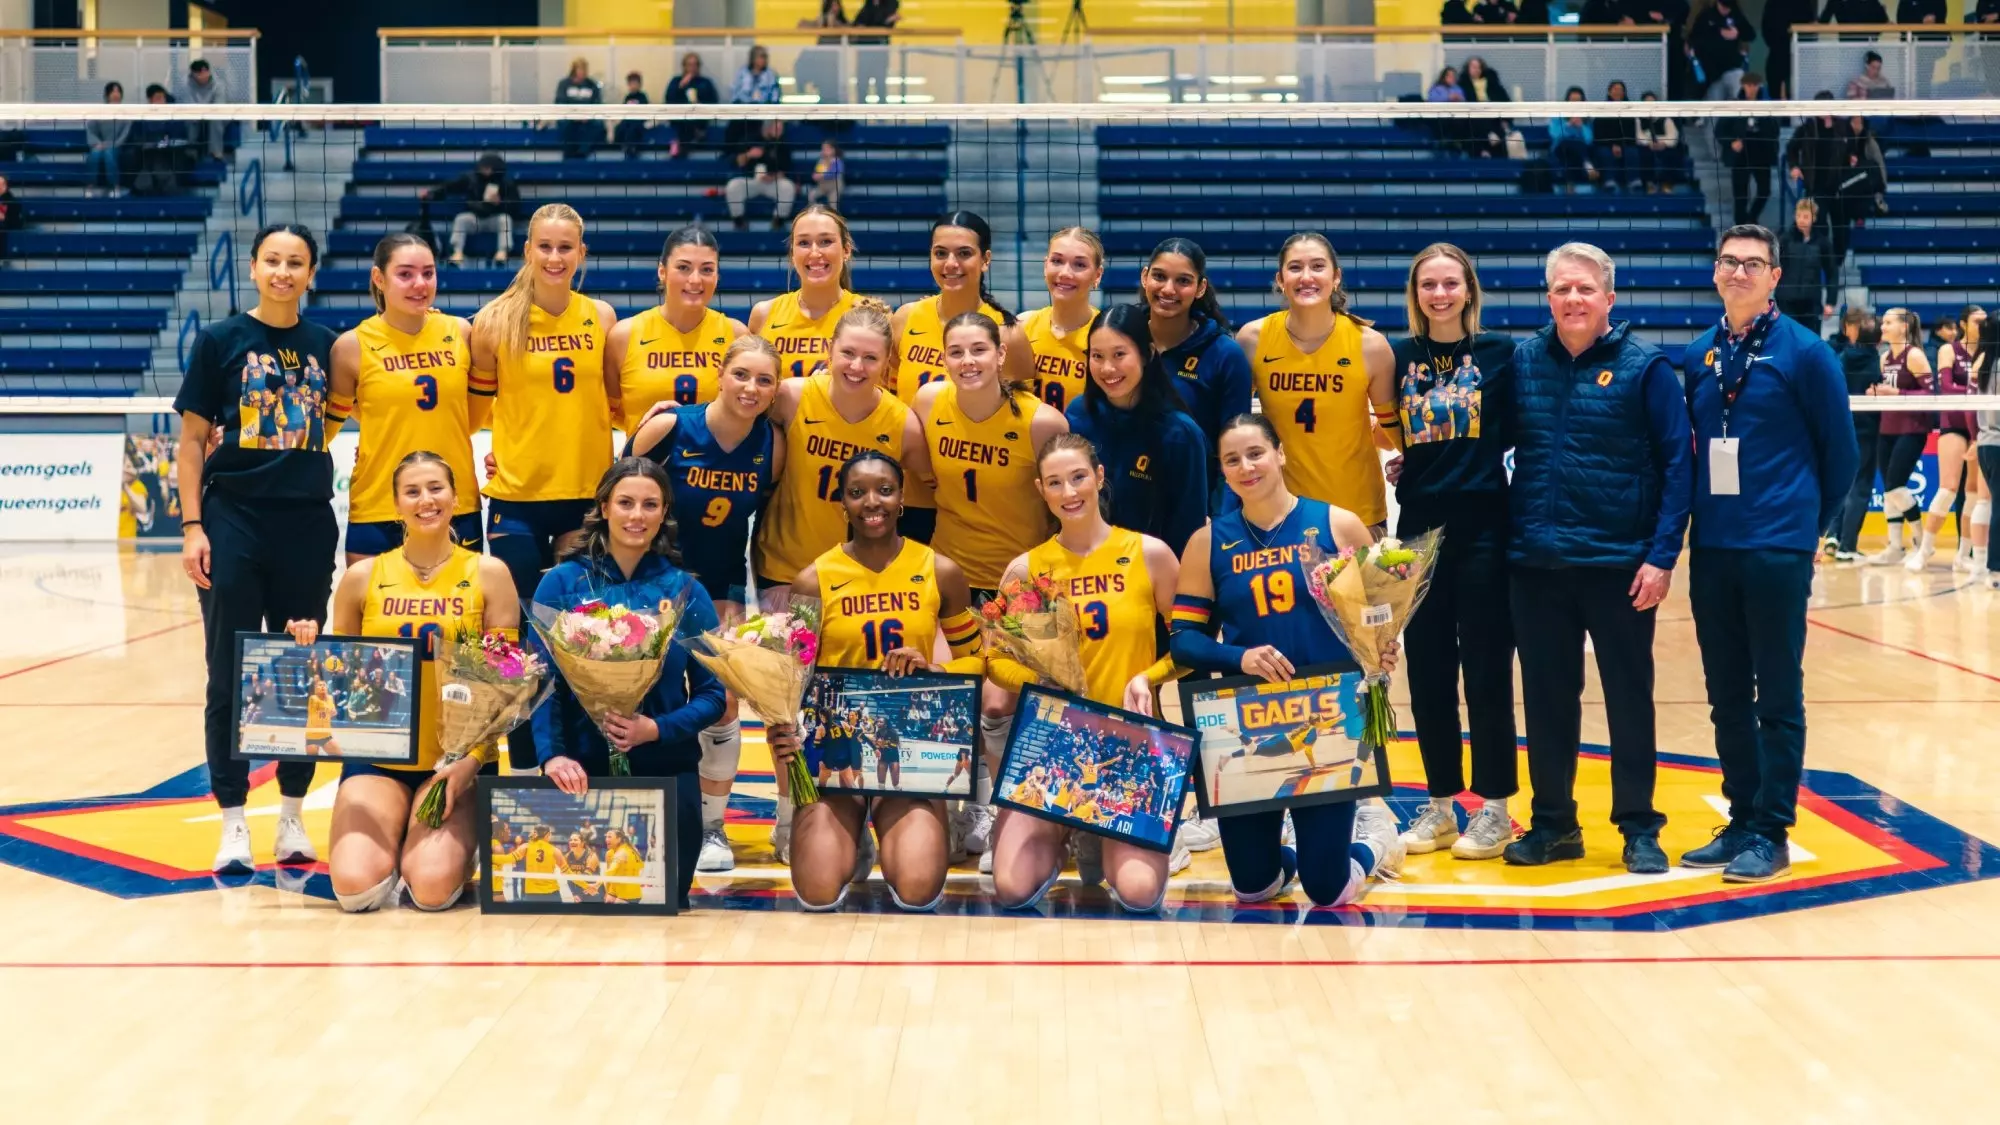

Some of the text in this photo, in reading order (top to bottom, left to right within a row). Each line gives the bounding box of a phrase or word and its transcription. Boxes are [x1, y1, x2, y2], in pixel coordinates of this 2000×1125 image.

[774, 336, 833, 354] QUEEN
[907, 345, 944, 367] QUEE
[383, 350, 456, 372] QUEEN'S
[647, 352, 722, 368] QUEEN'S
[552, 357, 575, 393] 6
[1269, 372, 1344, 393] QUEEN'S
[414, 374, 438, 411] 3
[1295, 398, 1316, 434] 4
[938, 436, 1010, 467] QUEEN'S
[0, 461, 93, 480] eensgaels
[687, 466, 758, 492] QUEEN'S
[963, 468, 977, 503] 1
[702, 496, 732, 528] 9
[1232, 544, 1311, 574] QUEEN'S
[1071, 573, 1125, 596] EEN'S
[1250, 570, 1296, 617] 19
[382, 597, 464, 616] QUEEN'S
[842, 592, 920, 616] QUEEN'S
[1075, 600, 1109, 641] 3
[861, 618, 904, 660] 16
[1242, 691, 1341, 729] GAELS
[536, 850, 544, 862] 3
